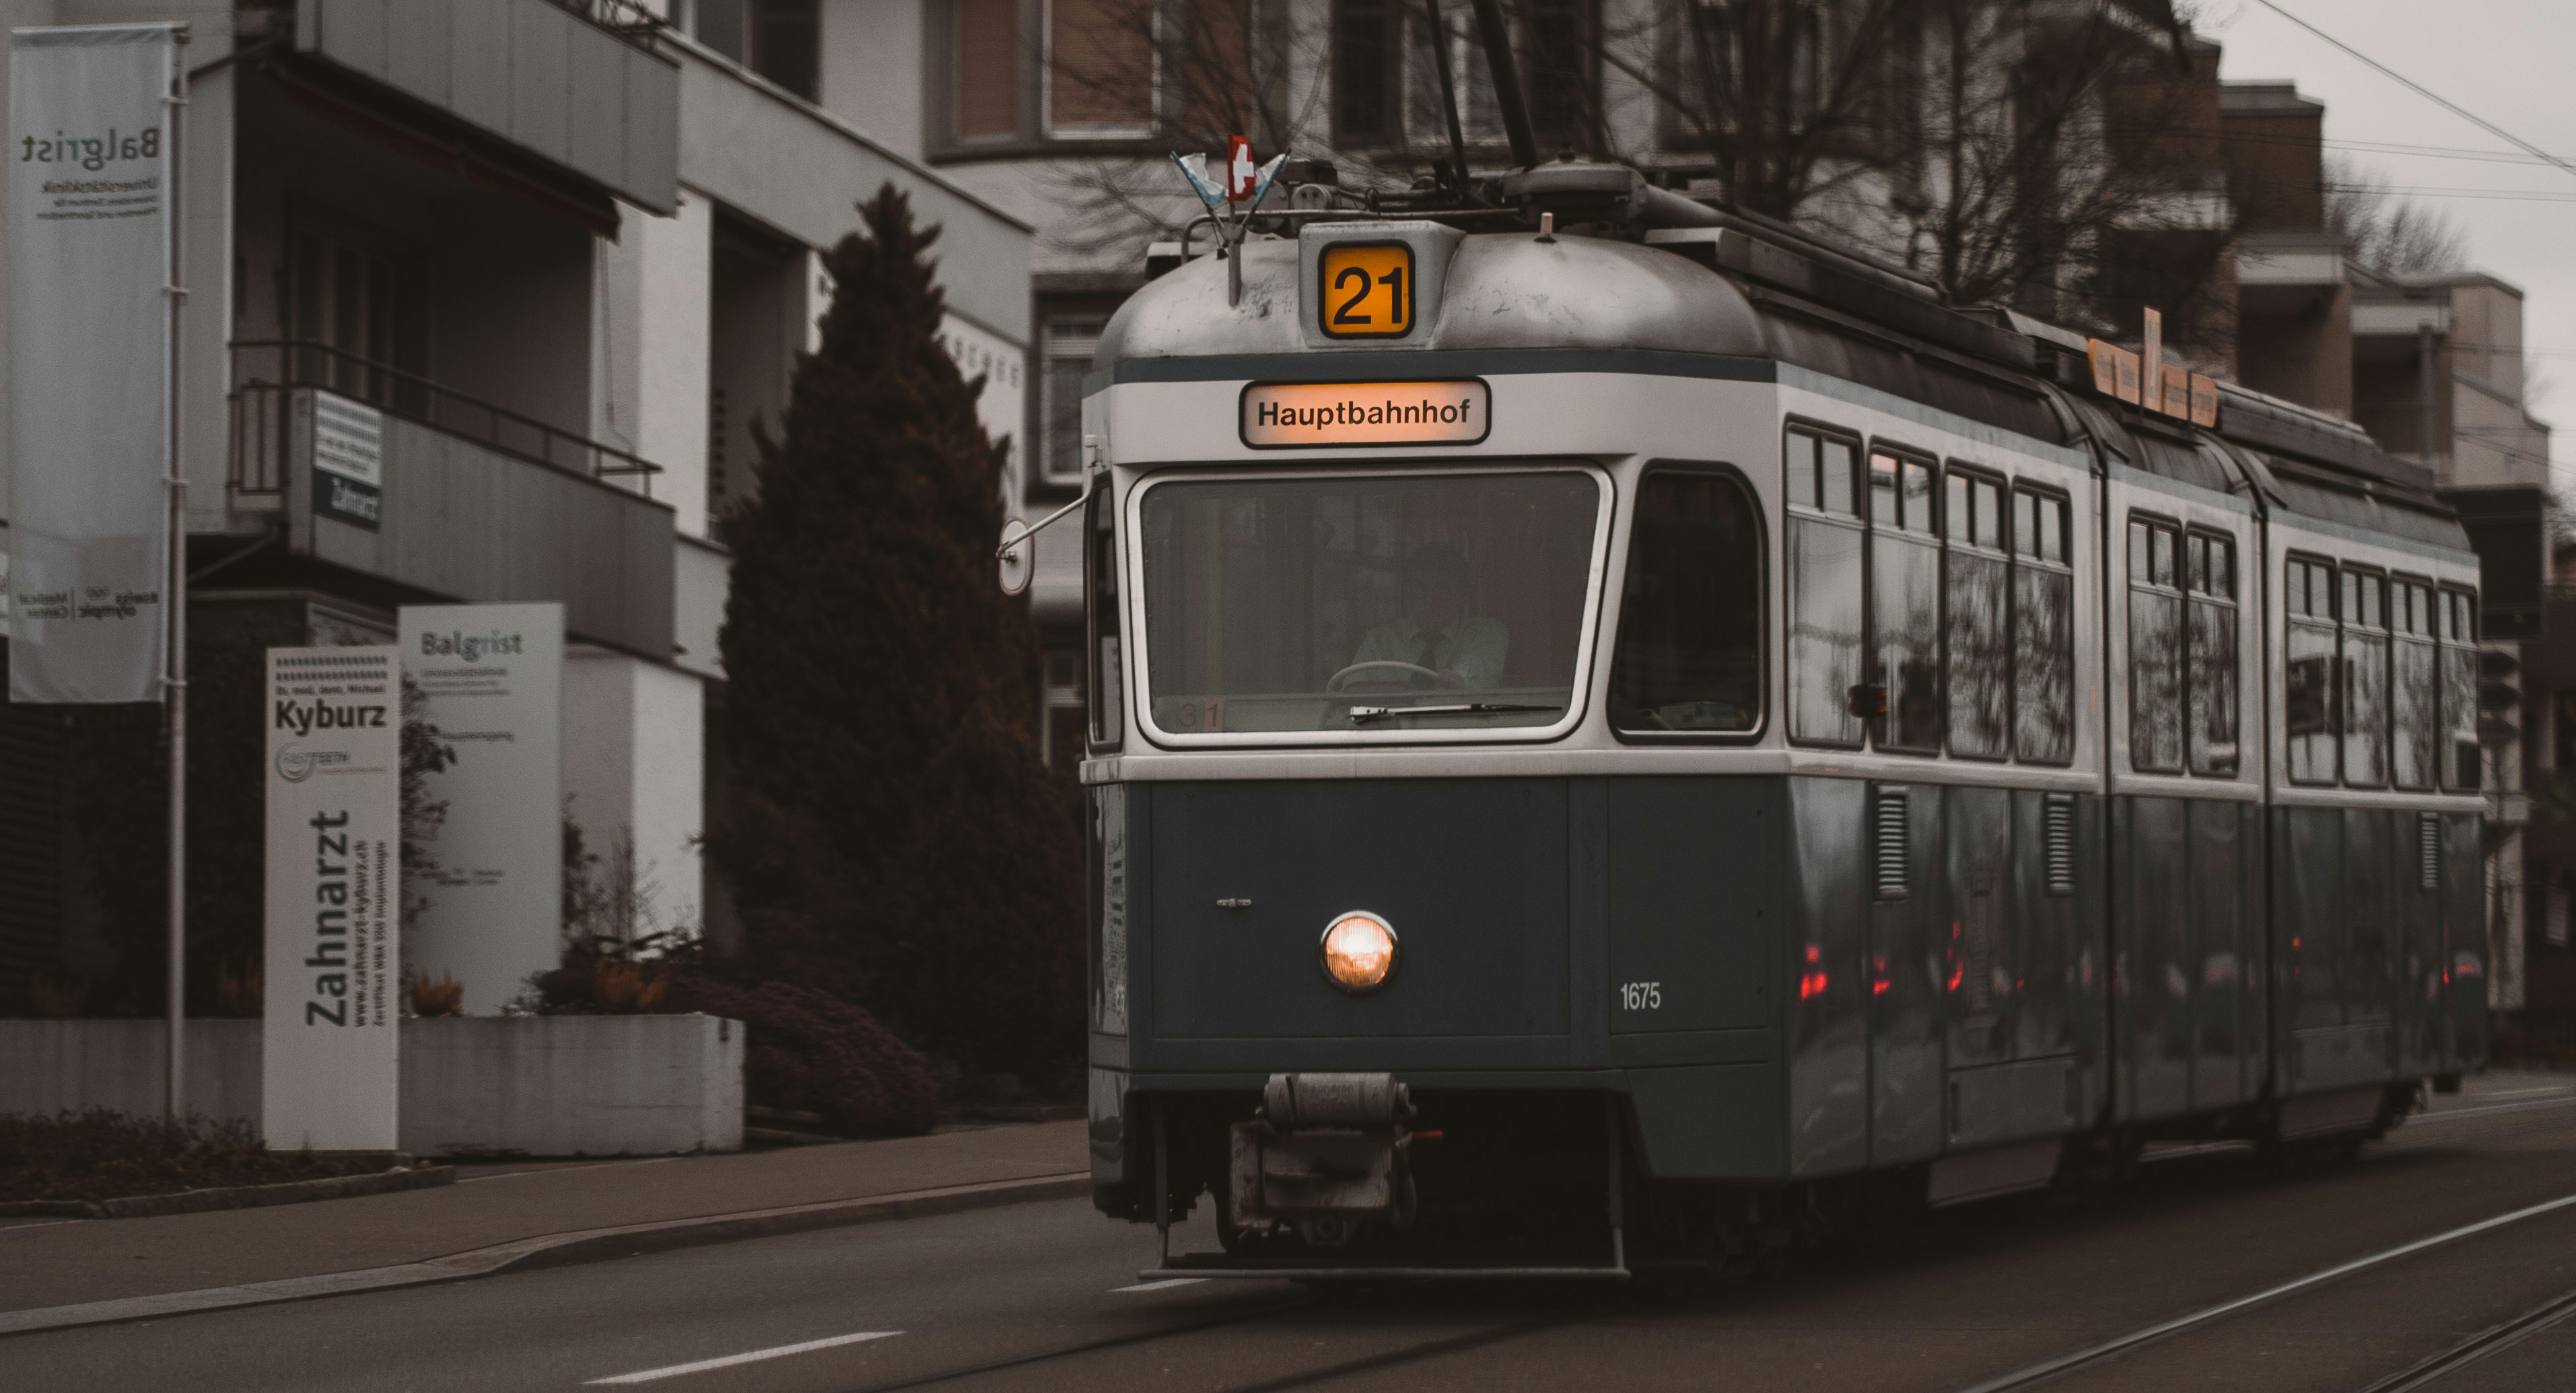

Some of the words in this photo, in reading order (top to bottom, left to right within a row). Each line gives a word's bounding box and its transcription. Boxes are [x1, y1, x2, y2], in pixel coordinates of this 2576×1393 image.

[1333, 267, 1403, 325] 21
[1257, 399, 1471, 430] Hauptbahnhof
[421, 630, 524, 662] Balgrist
[275, 699, 387, 737] Kyburz
[1179, 703, 1218, 728] 31
[305, 810, 349, 1027] Zahnarzt
[353, 840, 371, 1027] www.zahnarzt-kyburz.ch
[1621, 982, 1661, 1009] 1675
